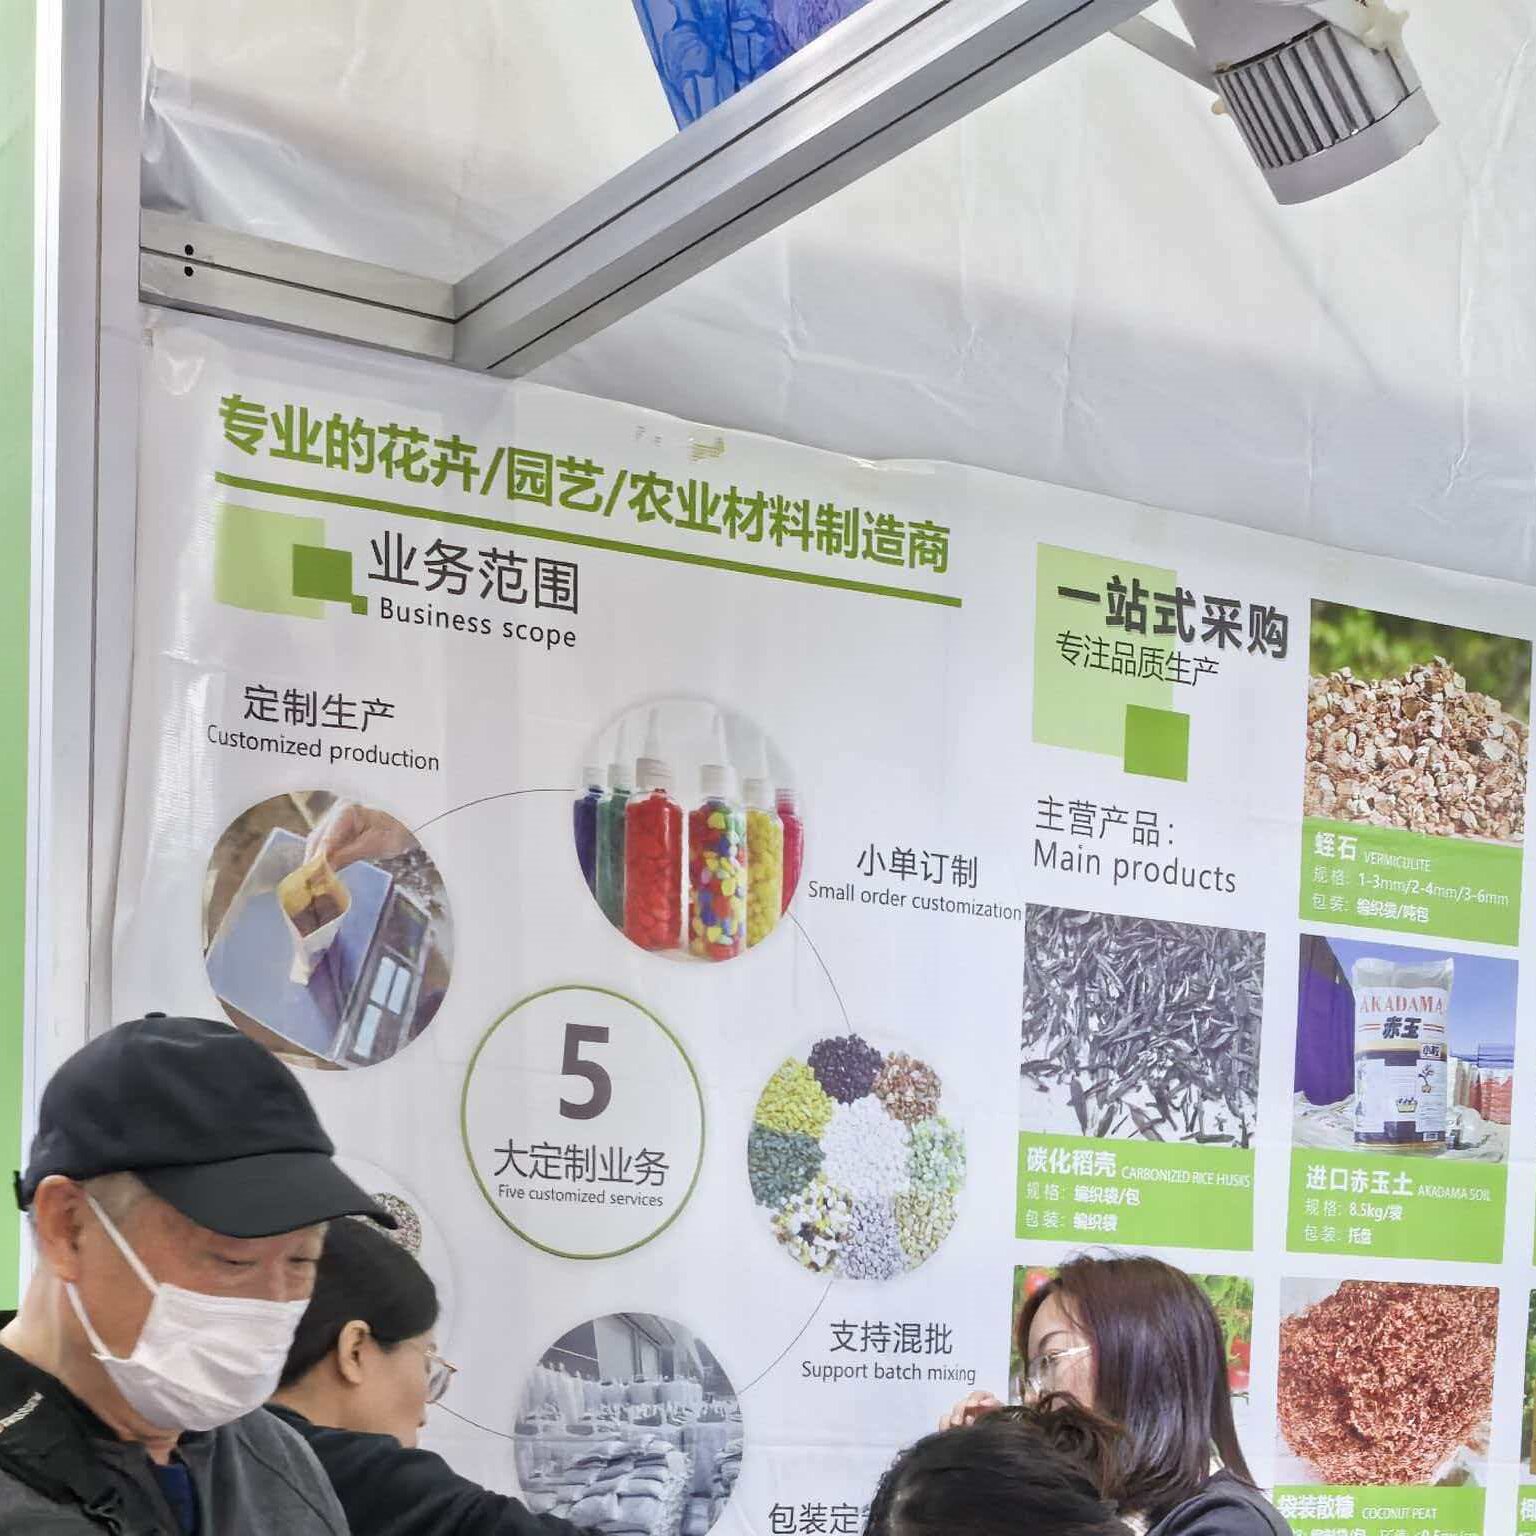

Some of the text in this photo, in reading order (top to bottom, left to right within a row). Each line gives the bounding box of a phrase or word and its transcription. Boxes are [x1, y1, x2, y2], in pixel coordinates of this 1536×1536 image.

[218, 395, 951, 575] 专业的花卉/园艺/农业材料制造商
[368, 530, 581, 615] 业务范围
[380, 597, 577, 651] Business scope
[1057, 575, 1289, 659] 一站式采购
[1056, 630, 1220, 686] 专注品质生产
[243, 683, 396, 734] 定制生产
[207, 724, 441, 774] Customized production
[857, 843, 978, 889] 小单订制
[1033, 838, 1237, 894] Main products
[1314, 831, 1432, 873] 蛭石 VERMICULITE
[808, 881, 1022, 921] Small order customization
[558, 1022, 613, 1121] 5
[493, 1137, 670, 1187] 大定制业务
[1027, 1147, 1117, 1178] 碳化稻壳
[1306, 1165, 1414, 1197] 进口赤玉土
[498, 1184, 664, 1208] Five customized services
[829, 1318, 954, 1356] 支持混批
[802, 1361, 977, 1385] Support batch mixing
